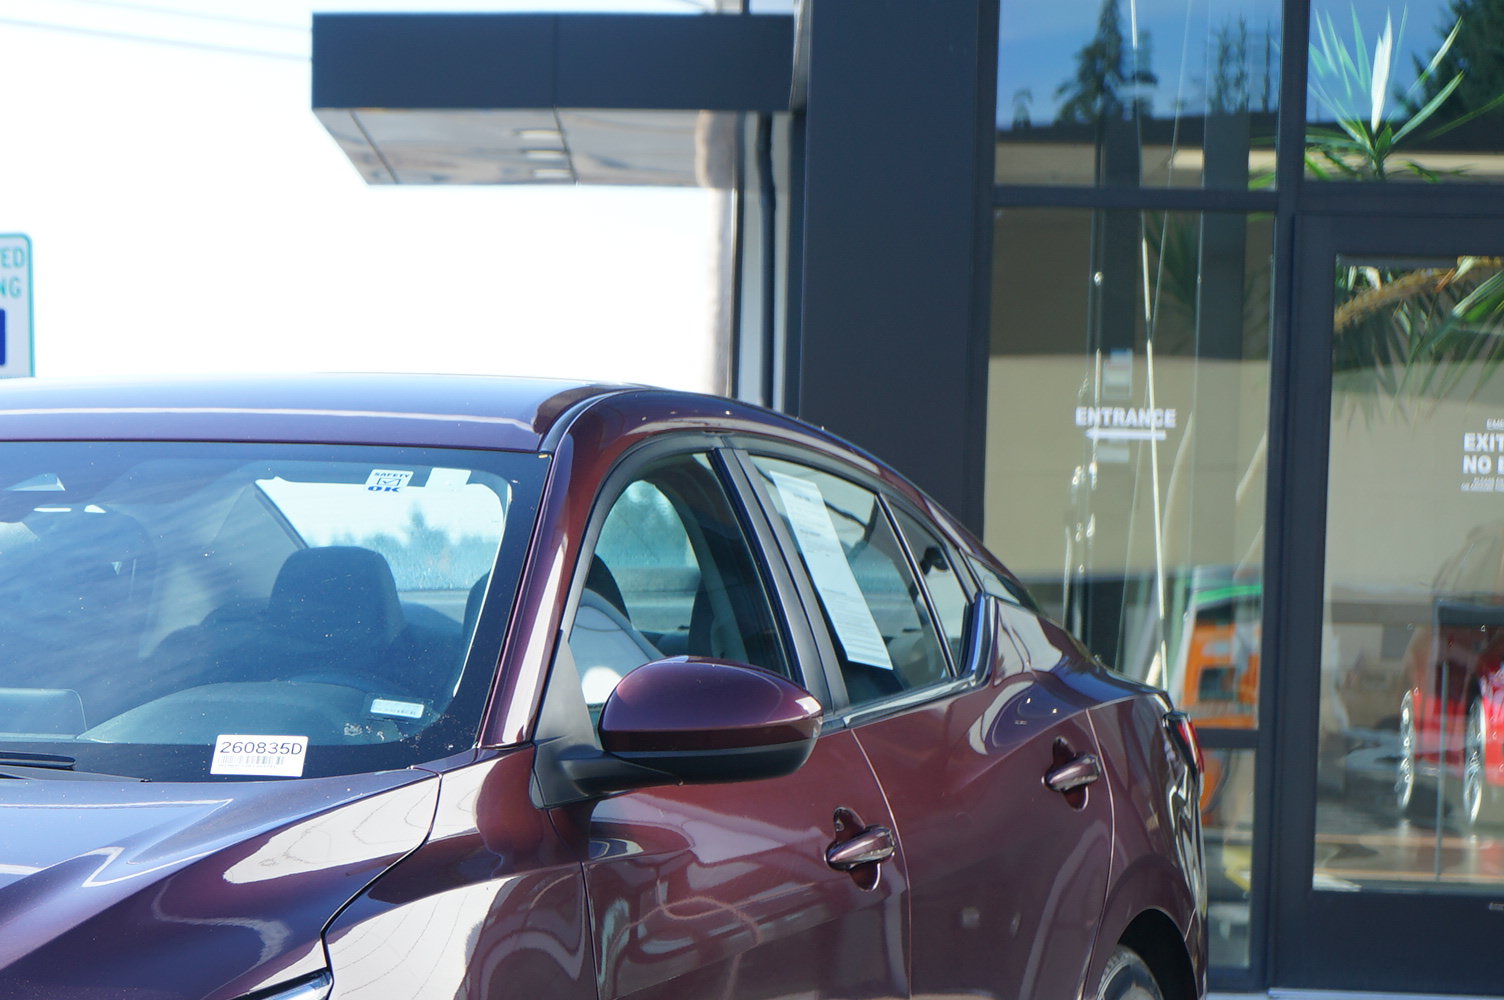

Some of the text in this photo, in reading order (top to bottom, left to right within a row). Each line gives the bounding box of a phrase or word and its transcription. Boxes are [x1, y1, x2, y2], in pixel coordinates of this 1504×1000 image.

[1075, 406, 1176, 428] ENTRANCE
[1462, 454, 1492, 474] NO
[368, 485, 401, 493] OK
[219, 741, 303, 755] 260835D
